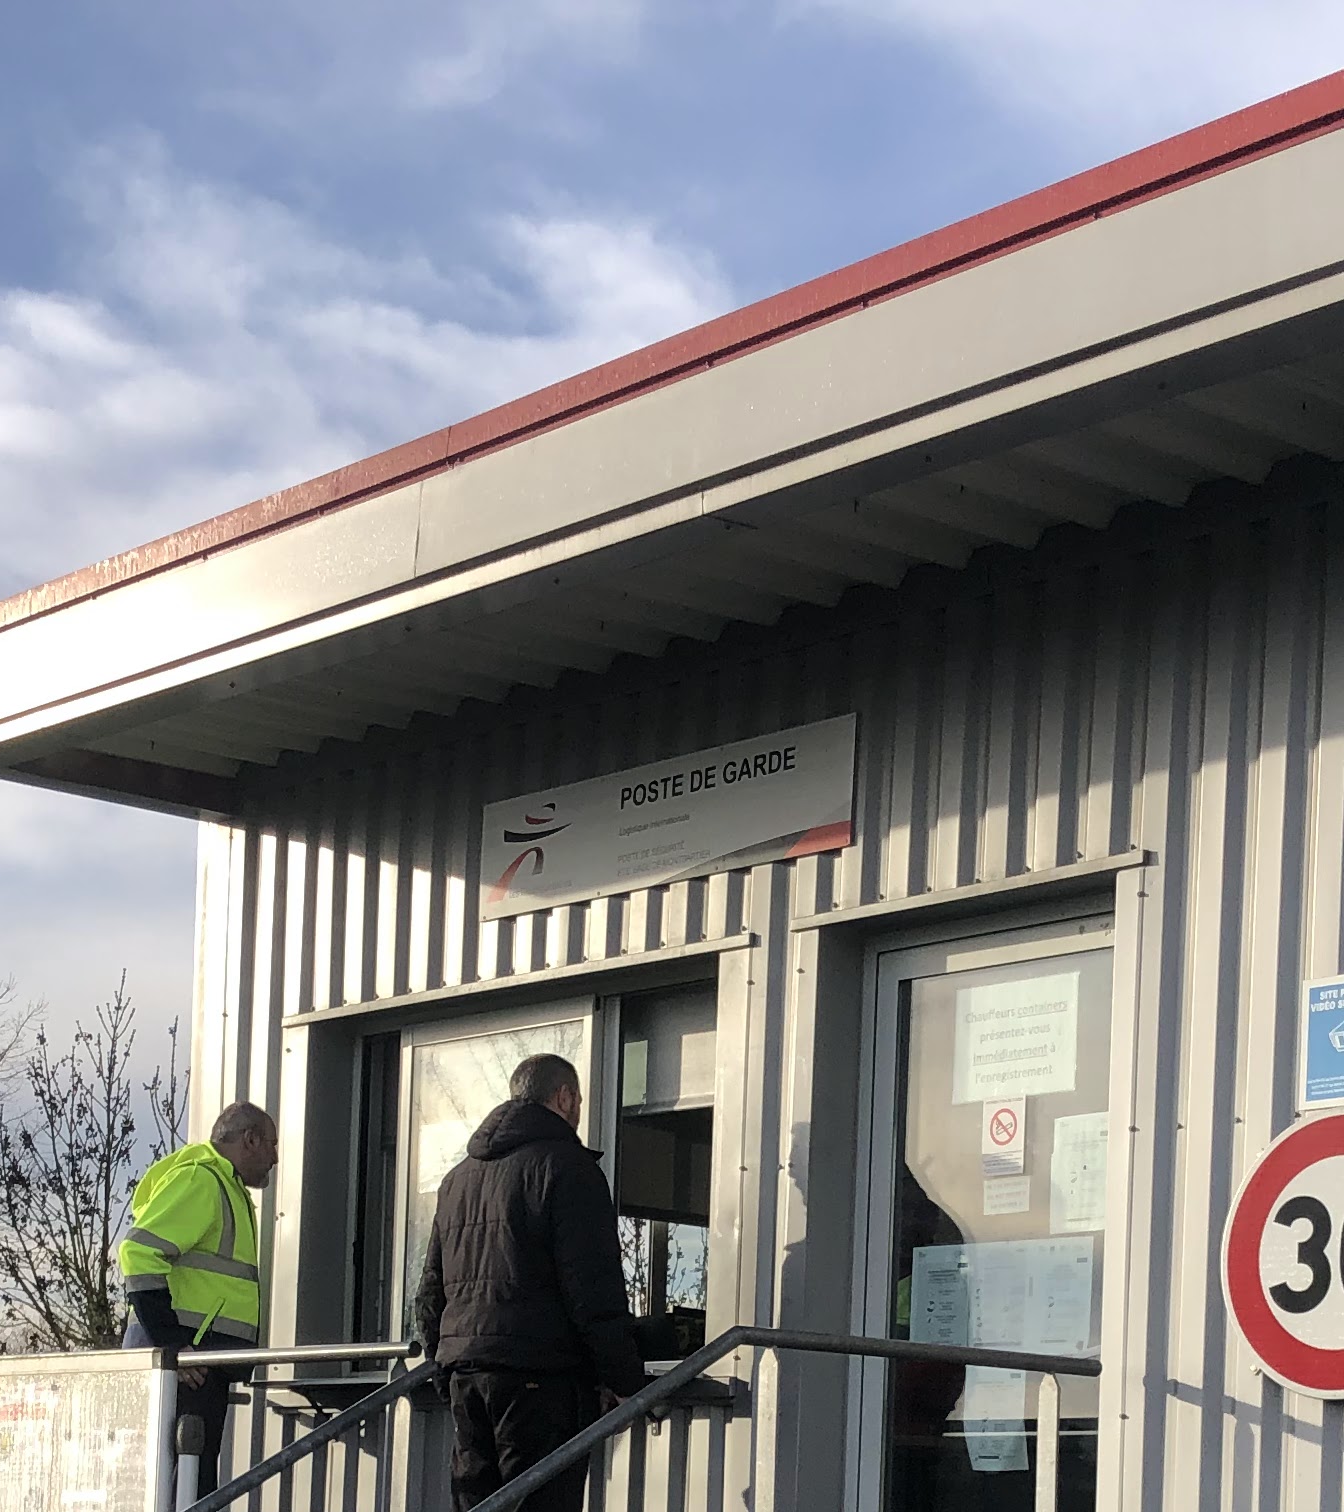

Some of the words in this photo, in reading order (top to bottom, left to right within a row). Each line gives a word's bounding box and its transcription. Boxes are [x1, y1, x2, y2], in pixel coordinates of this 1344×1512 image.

[620, 774, 684, 810] POSTE
[690, 765, 716, 793] DE
[722, 746, 796, 784] GARDE
[1319, 989, 1338, 1000] SITE
[965, 1008, 1016, 1024] Chauffeurs
[1017, 1000, 1068, 1018] containers
[1311, 1001, 1336, 1012] VIDÉO
[1049, 1042, 1056, 1053] à
